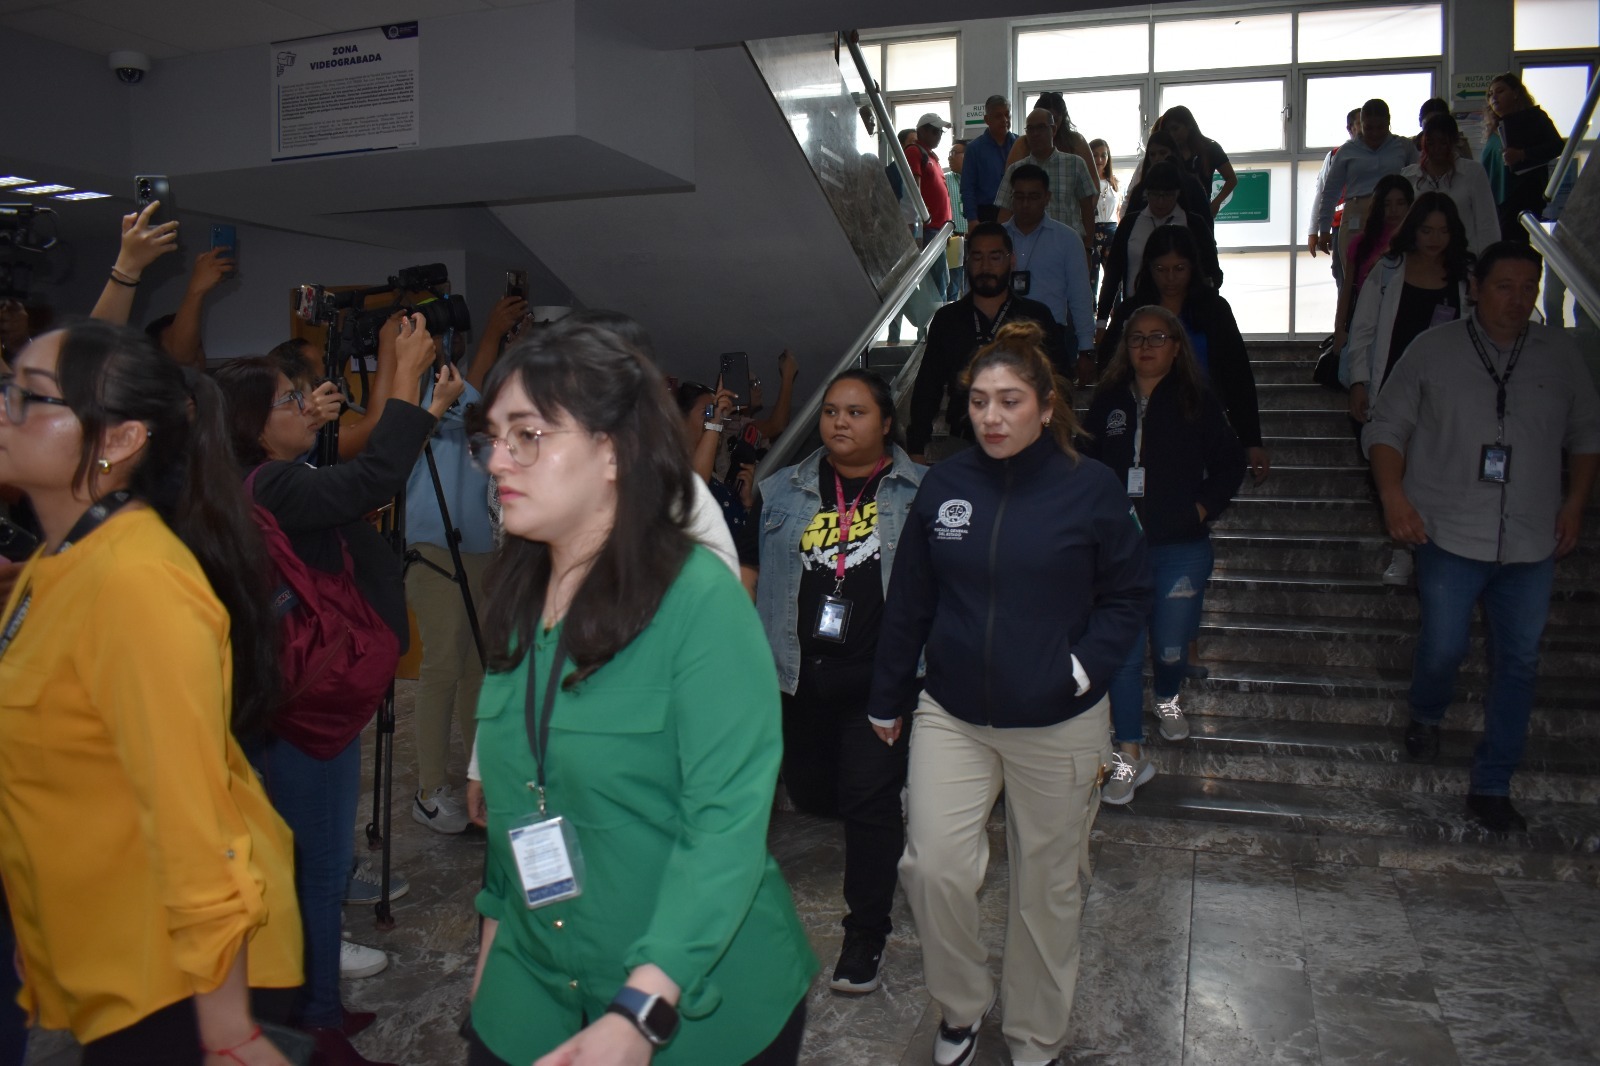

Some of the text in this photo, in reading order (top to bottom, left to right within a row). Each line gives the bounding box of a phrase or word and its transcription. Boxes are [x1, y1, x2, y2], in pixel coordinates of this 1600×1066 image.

[332, 44, 358, 56] ZONA
[310, 53, 382, 70] VIDEOGRABADA
[806, 501, 878, 531] STAR
